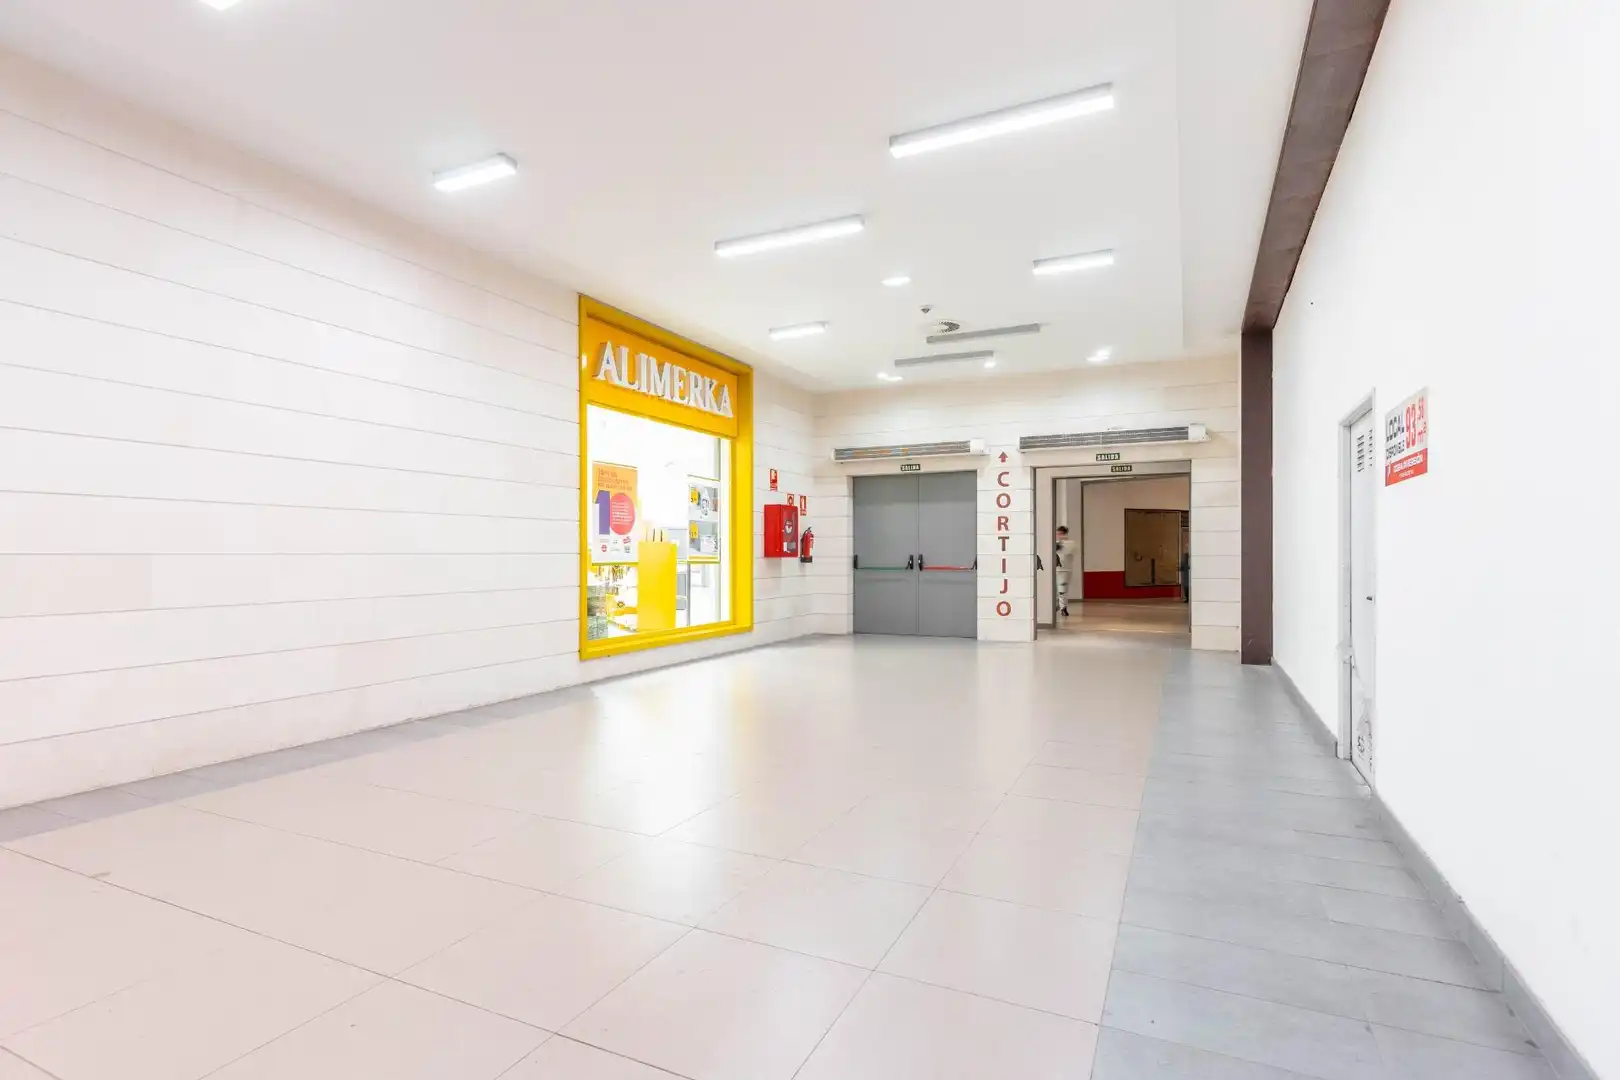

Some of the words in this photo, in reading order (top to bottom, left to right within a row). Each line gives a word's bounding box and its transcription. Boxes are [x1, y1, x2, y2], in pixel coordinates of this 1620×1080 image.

[595, 340, 734, 418] ALIMERKA
[1406, 404, 1416, 449] 93
[996, 471, 1011, 616] CORTIJO
